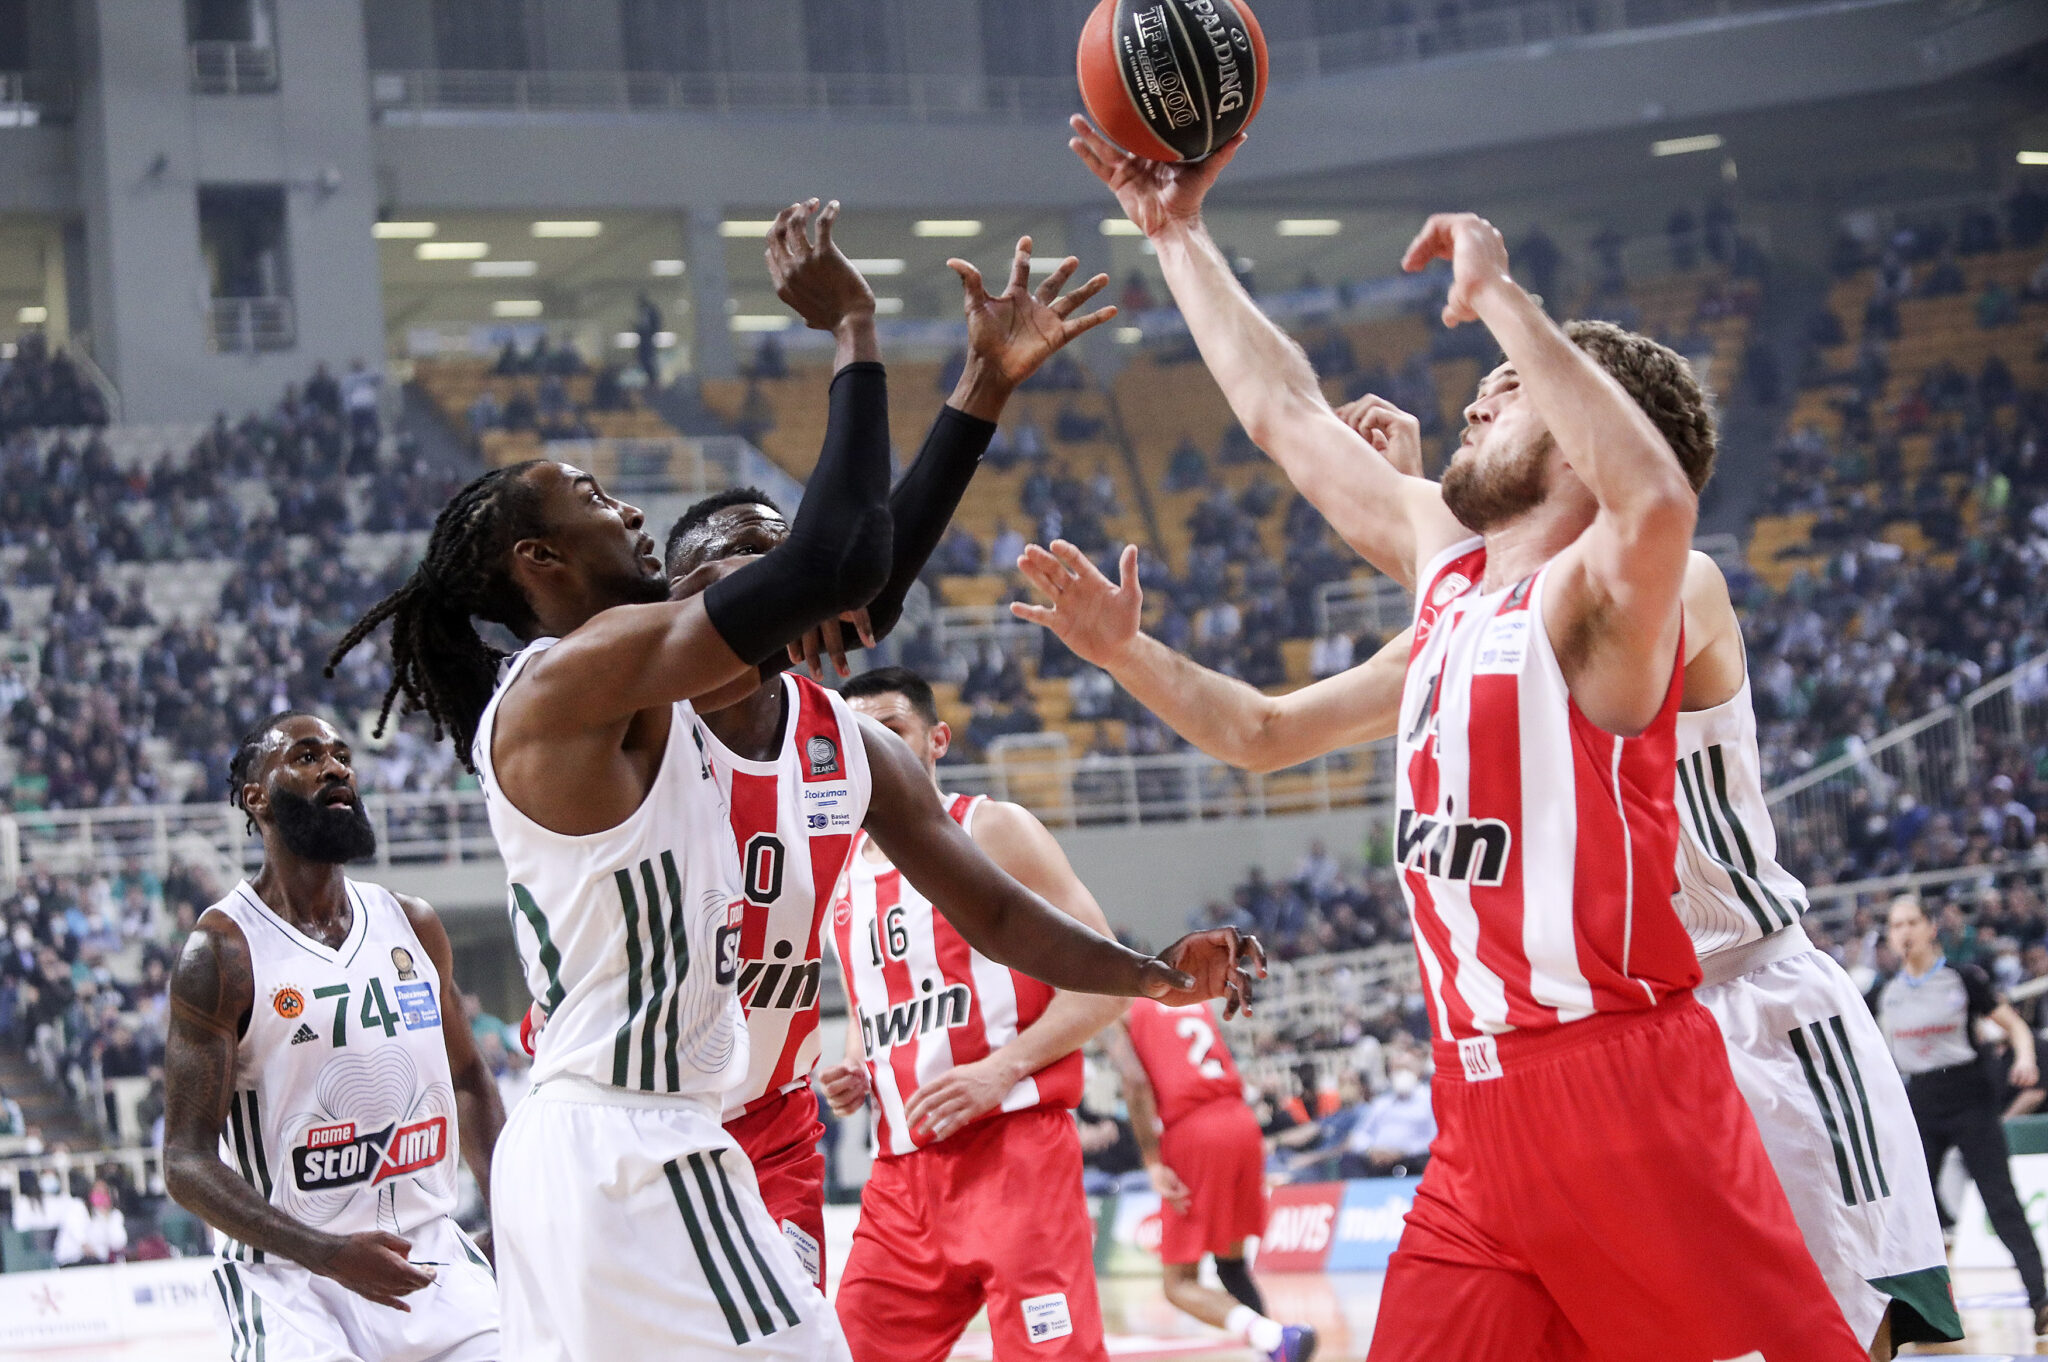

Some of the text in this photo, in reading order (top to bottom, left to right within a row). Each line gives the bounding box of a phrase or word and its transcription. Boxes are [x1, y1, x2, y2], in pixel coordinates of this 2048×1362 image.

[1123, 35, 1157, 120] DEEP CHANNEL DESIGN
[1137, 49, 1162, 96] LEGACY
[1139, 6, 1194, 127] TF-1000
[1185, 0, 1244, 120] PALDING.
[804, 789, 847, 799] Stoiximan
[1397, 793, 1508, 882] win
[868, 906, 909, 967] 16
[313, 977, 400, 1048] 74
[859, 978, 969, 1058] bwin
[1176, 1016, 1225, 1079] 2
[311, 1126, 351, 1148] pame
[1262, 1202, 1335, 1254] AVIS
